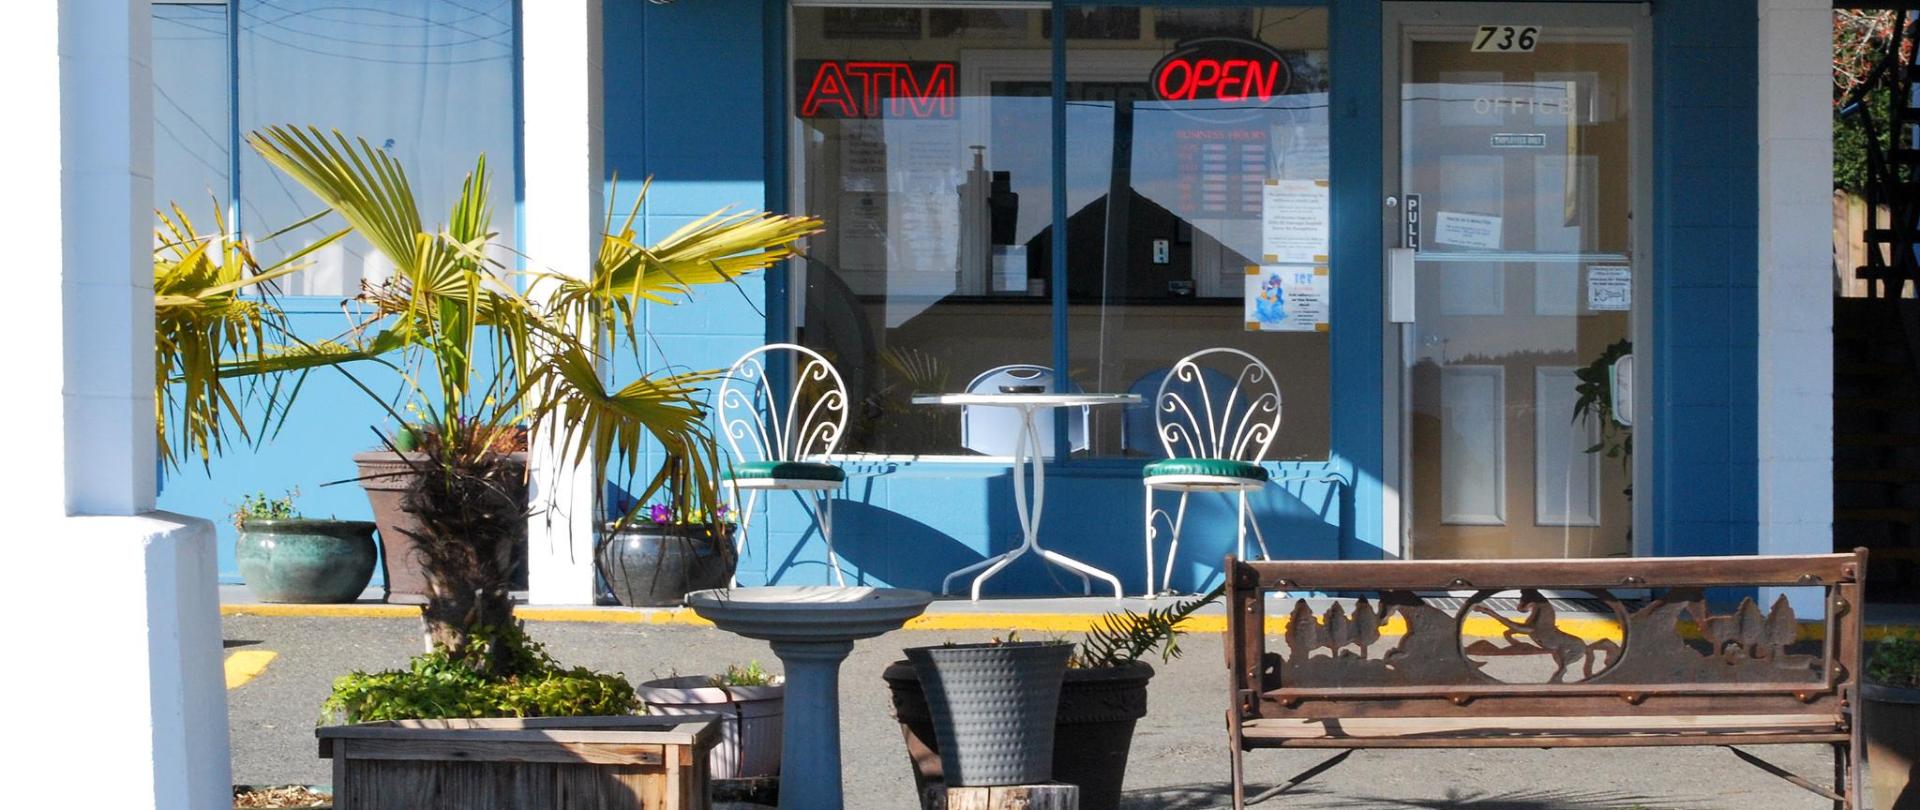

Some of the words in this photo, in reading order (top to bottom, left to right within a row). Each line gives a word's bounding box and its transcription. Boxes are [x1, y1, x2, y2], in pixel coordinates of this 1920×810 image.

[1476, 26, 1538, 50] 736
[802, 60, 955, 117] ATM
[1159, 59, 1278, 102] OPEN
[1474, 97, 1574, 116] OFFICE
[1408, 199, 1417, 248] PULL
